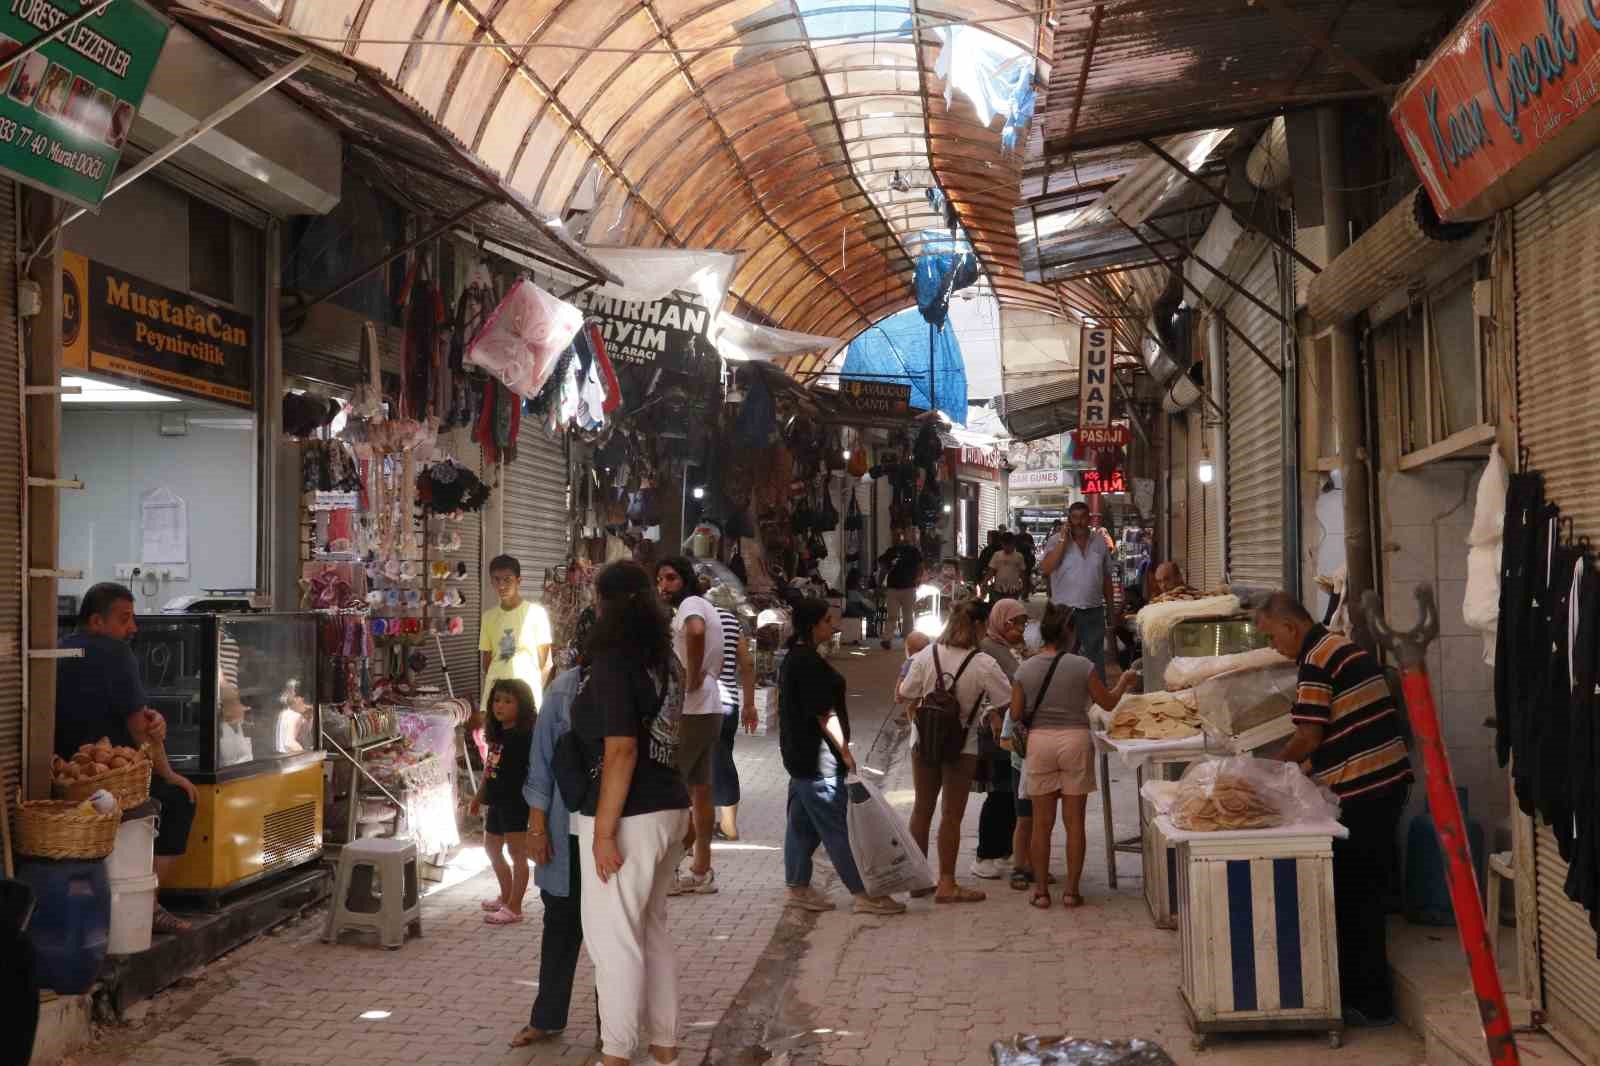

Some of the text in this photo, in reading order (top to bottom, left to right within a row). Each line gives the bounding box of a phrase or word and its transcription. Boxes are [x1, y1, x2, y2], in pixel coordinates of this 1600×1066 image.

[67, 21, 132, 78] LEZZETLER
[16, 126, 33, 147] 77
[31, 134, 48, 155] 40
[106, 275, 248, 347] MustafaCan
[135, 320, 225, 366] Peynircilik
[1086, 331, 1106, 421] SUNAR
[1080, 429, 1123, 443] PASAJI
